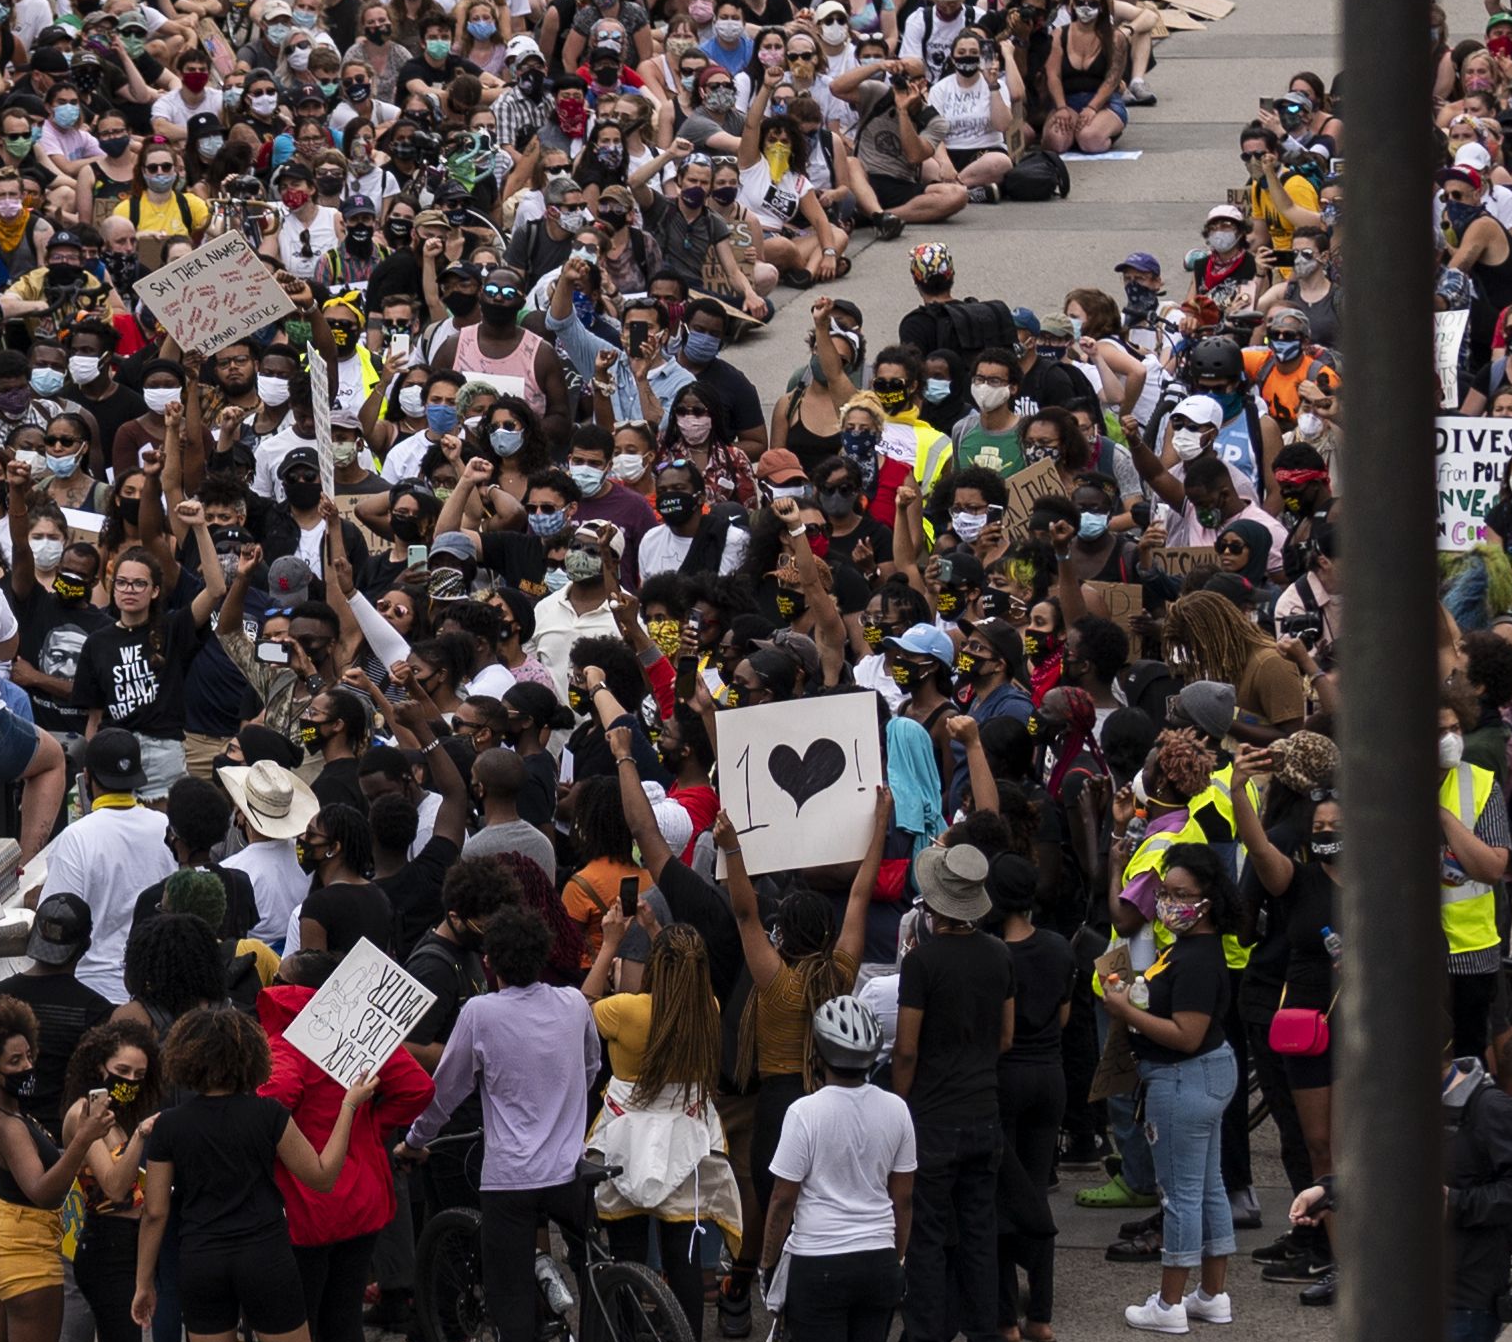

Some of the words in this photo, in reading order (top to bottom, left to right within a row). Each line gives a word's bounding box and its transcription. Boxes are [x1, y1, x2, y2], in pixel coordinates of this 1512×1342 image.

[149, 276, 175, 298] SAY
[172, 257, 207, 284] THEIR
[207, 236, 254, 265] NAMES
[196, 323, 238, 356] DEMAND
[239, 303, 281, 331] JUSTICE
[1438, 459, 1467, 481] from
[112, 659, 155, 684] STILL
[119, 644, 143, 664] WE
[113, 676, 157, 704] CAN'T
[735, 743, 770, 836] 1
[349, 1006, 402, 1059] LIVES
